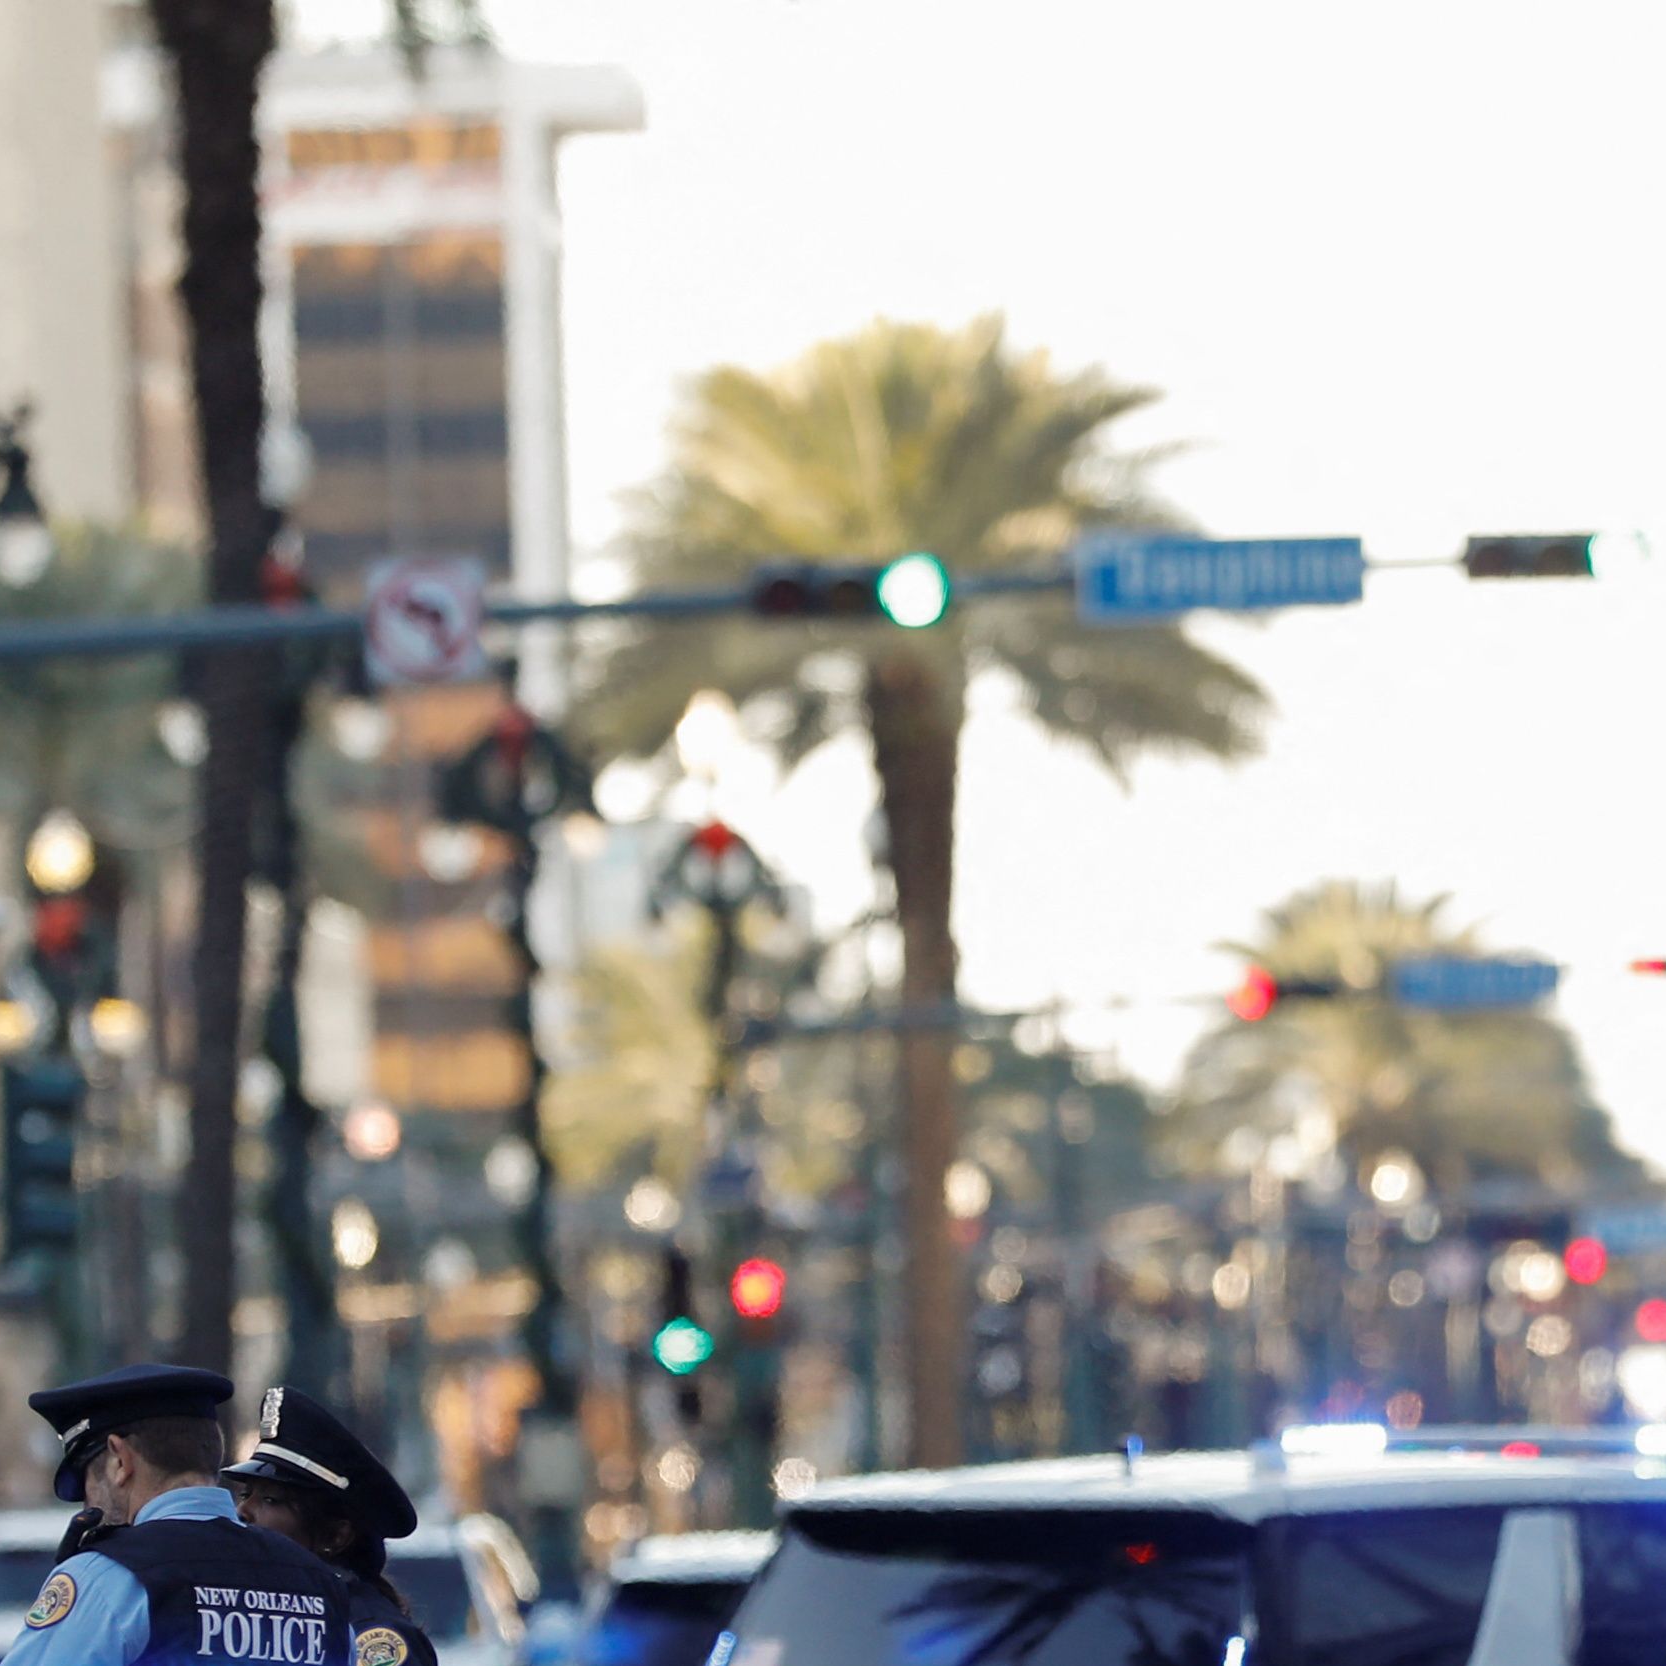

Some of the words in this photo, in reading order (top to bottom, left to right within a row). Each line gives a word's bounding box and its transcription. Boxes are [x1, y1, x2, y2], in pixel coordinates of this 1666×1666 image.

[193, 1586, 240, 1607] NEW
[244, 1589, 325, 1615] ORLEANS
[197, 1609, 326, 1666] POLICE
